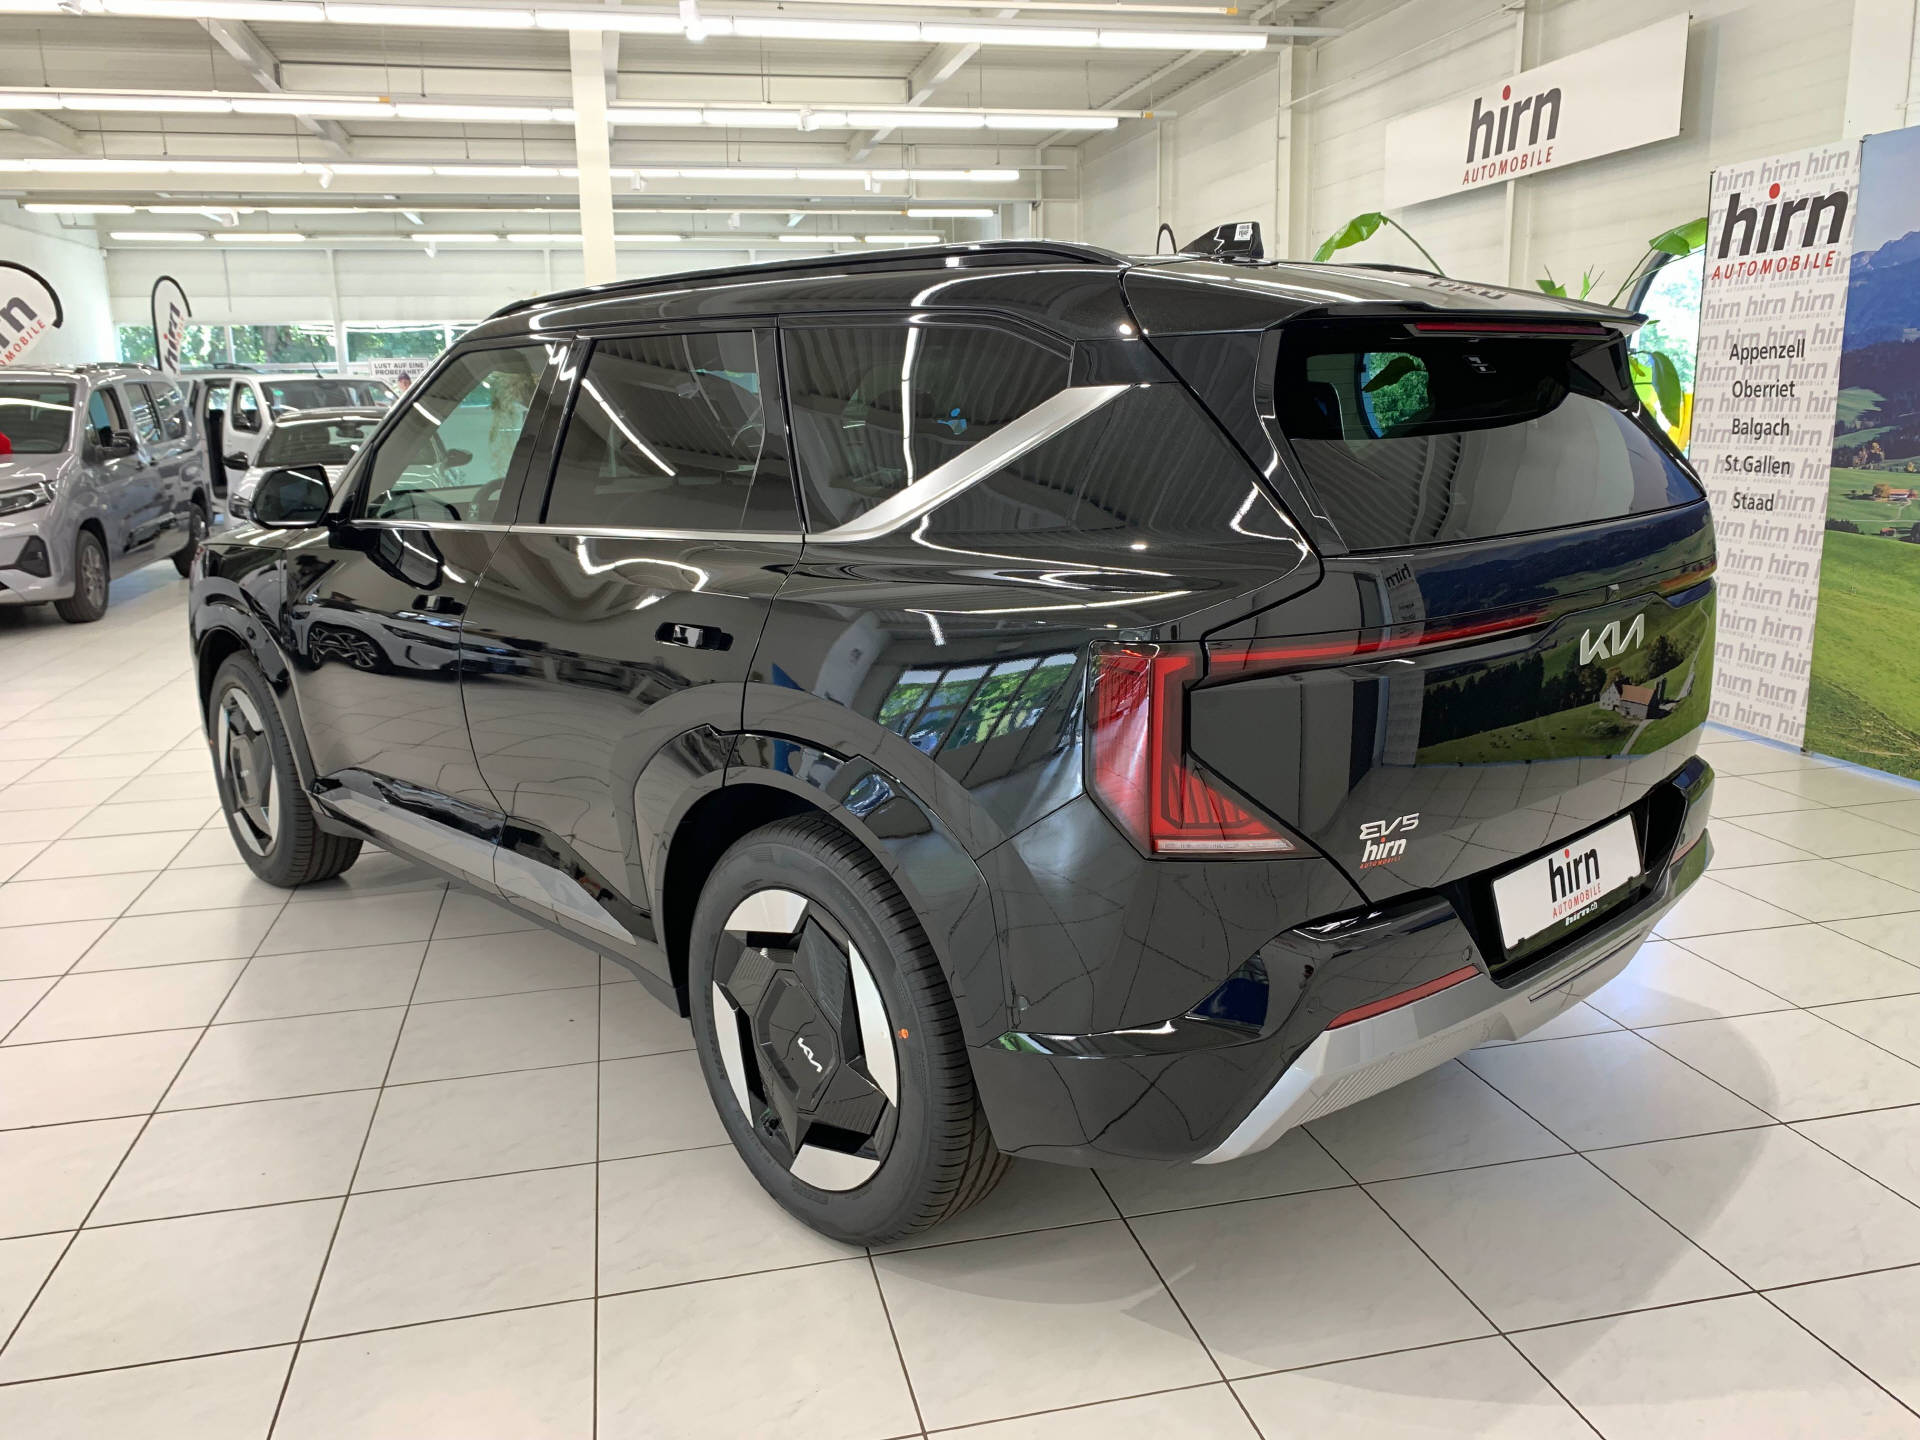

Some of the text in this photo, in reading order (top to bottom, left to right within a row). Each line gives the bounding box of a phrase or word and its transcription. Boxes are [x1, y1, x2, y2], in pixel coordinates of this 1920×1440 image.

[1466, 85, 1562, 164] hirn
[1462, 146, 1554, 186] AUTOMOBILE
[1715, 148, 1850, 192] hirn hirn hirn
[1717, 182, 1849, 260] hirn
[1711, 250, 1837, 281] AUTOMOBILE
[1704, 289, 1835, 320] hirn hirn hirn
[1729, 338, 1806, 366] Appenzell
[1699, 359, 1738, 381] hirn
[1786, 357, 1828, 379] hirn
[1732, 379, 1796, 399] Oberriet
[1694, 422, 1732, 443] hirn
[1731, 417, 1790, 441] Balgach
[1724, 454, 1791, 475] St.Gallen
[1733, 491, 1775, 511] Staad
[1774, 488, 1816, 513] hirn
[1749, 518, 1790, 543] hirn
[1723, 547, 1764, 571] hirn
[1767, 552, 1810, 578] hirn
[1742, 580, 1783, 606] hirn
[1719, 608, 1758, 633] hirn
[1761, 615, 1803, 641] hirn
[1737, 642, 1777, 669] hirn
[1716, 667, 1753, 694] hirn
[1756, 677, 1797, 705] hirn
[1734, 701, 1772, 730] hirn
[1359, 812, 1420, 840] EV5
[1361, 836, 1407, 863] hirn
[1548, 848, 1601, 904] hirn
[1552, 882, 1602, 919] AUTOMOBILE
